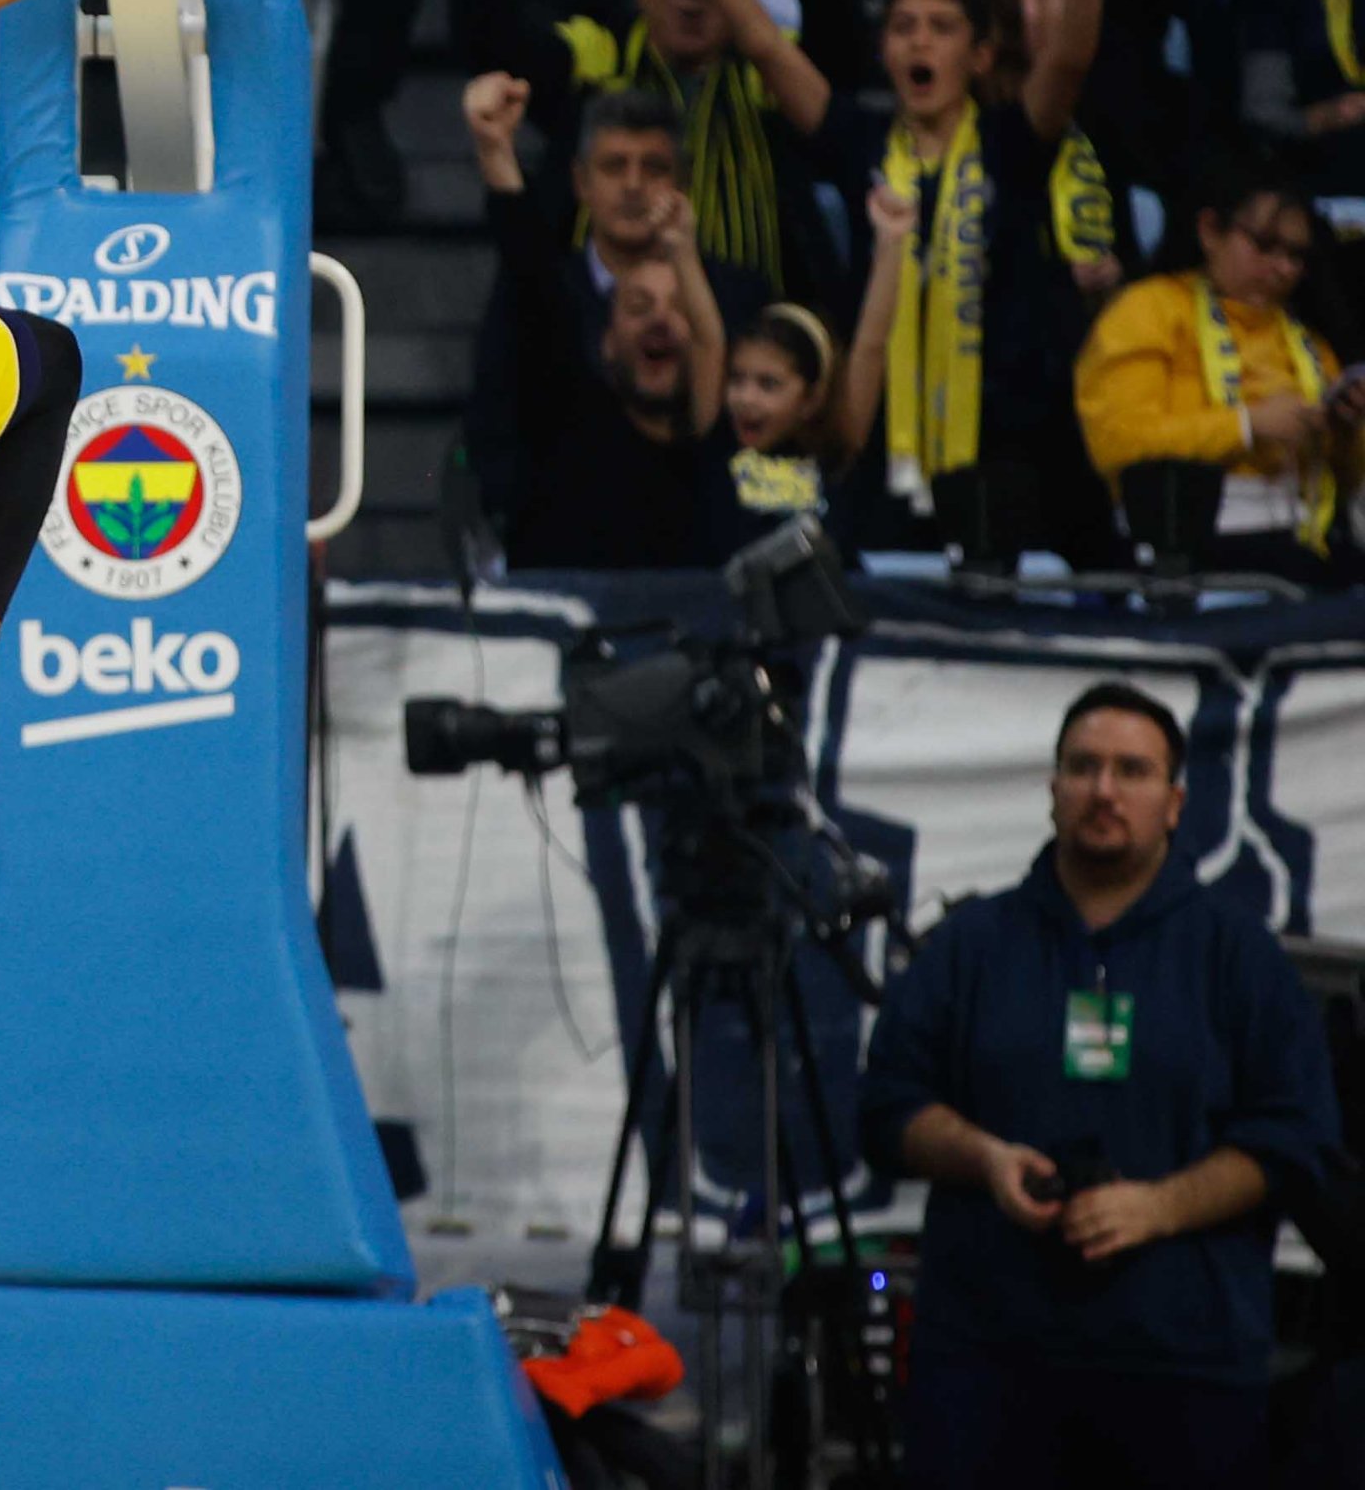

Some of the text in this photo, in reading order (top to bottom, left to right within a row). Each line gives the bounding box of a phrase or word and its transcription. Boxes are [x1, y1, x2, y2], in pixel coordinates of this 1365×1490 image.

[134, 392, 207, 439] SPOR
[105, 566, 163, 589] 1907
[19, 616, 241, 698] beko
